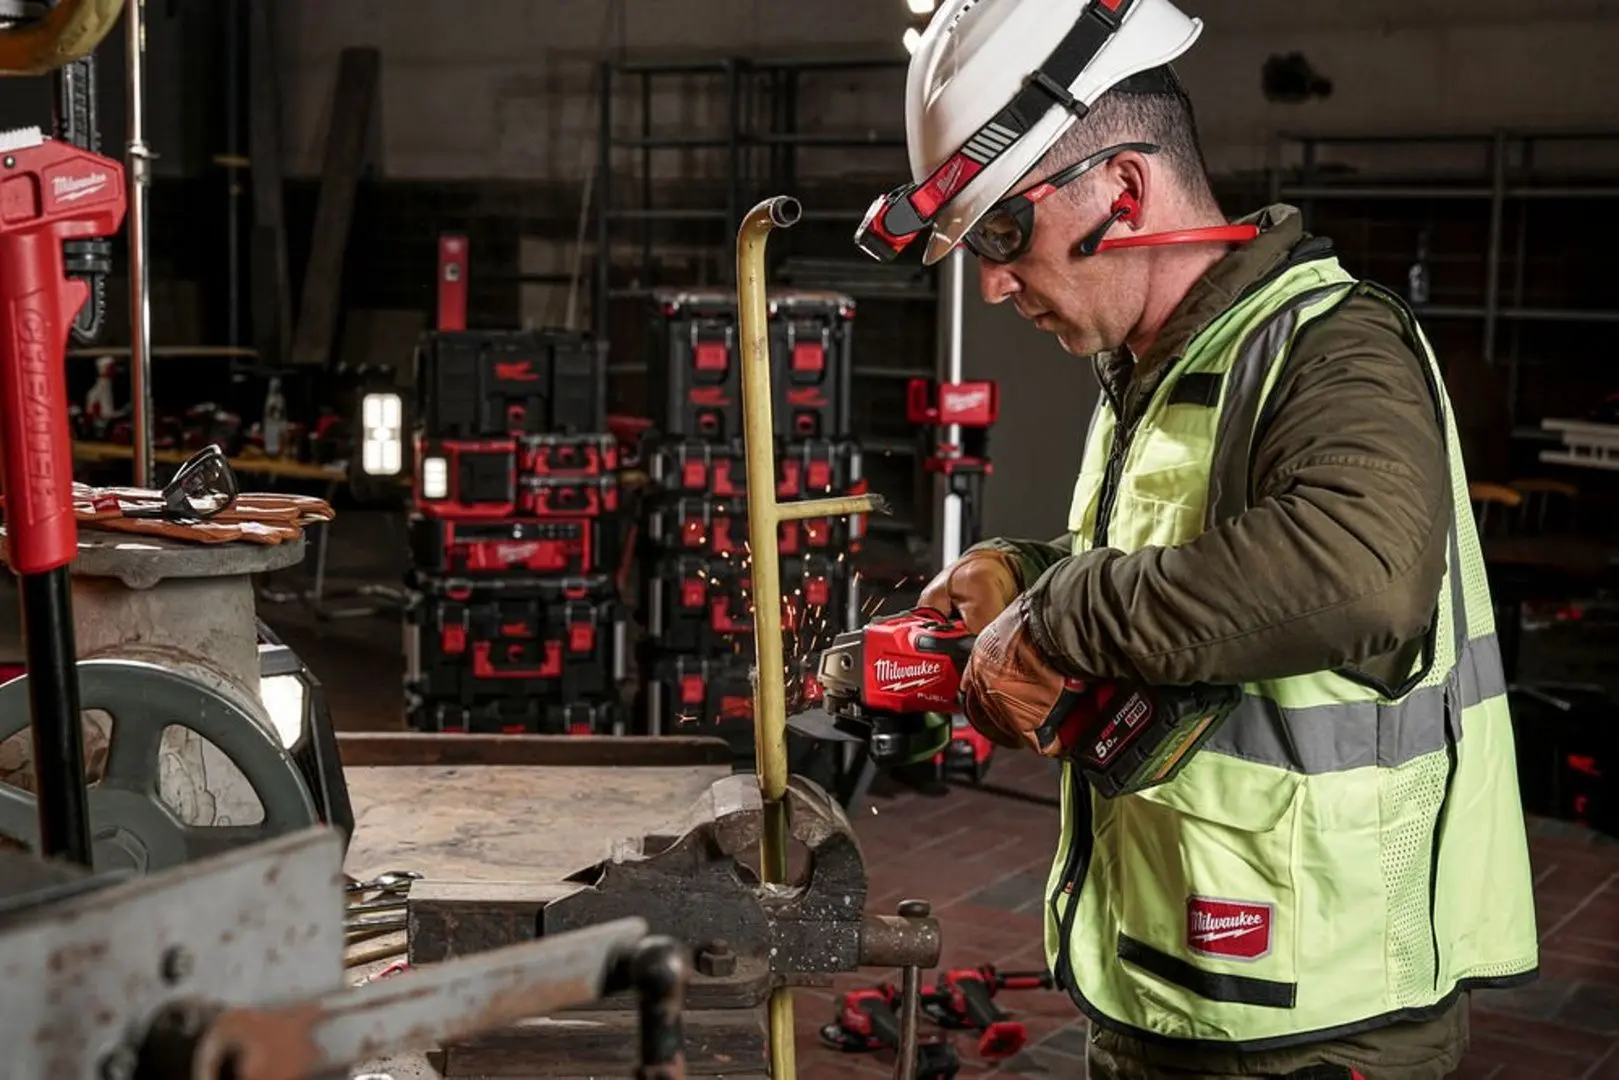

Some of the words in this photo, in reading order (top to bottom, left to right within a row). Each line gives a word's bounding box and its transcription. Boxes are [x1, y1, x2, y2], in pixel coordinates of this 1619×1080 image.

[874, 658, 941, 682] Milwaukee
[917, 691, 949, 703] FUEL
[1191, 910, 1264, 932] Milwaukee
